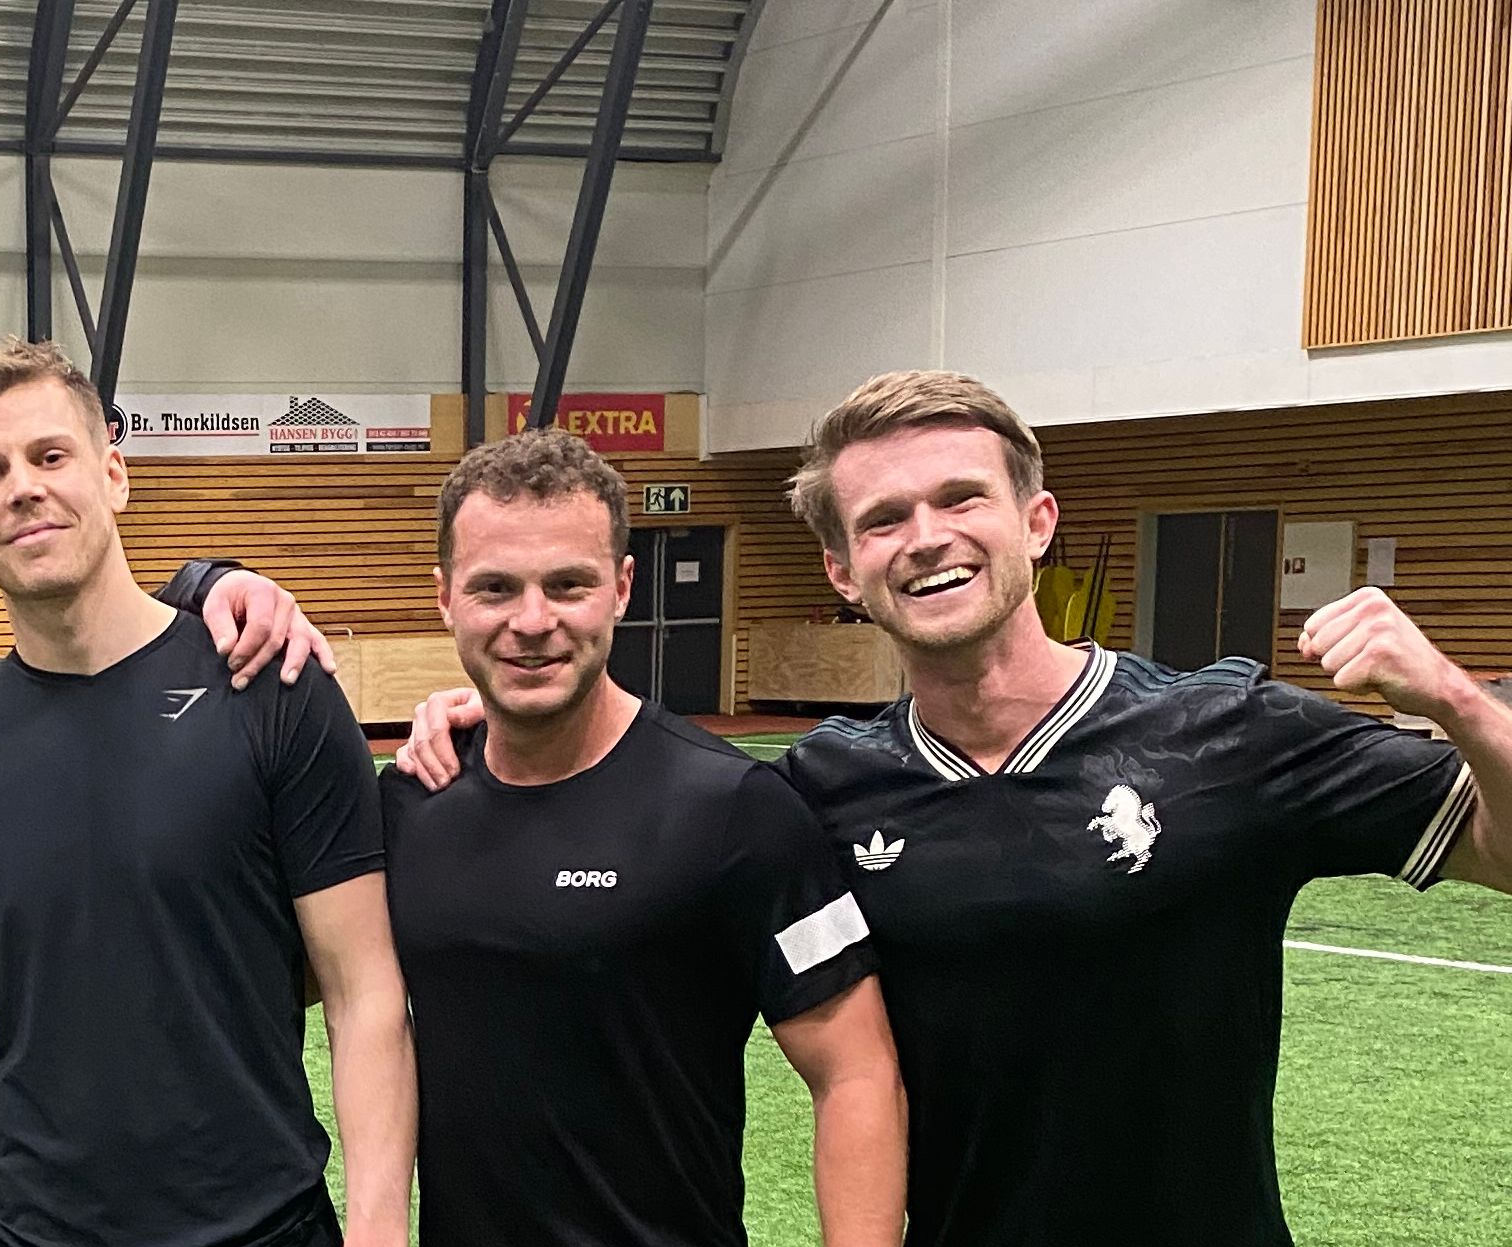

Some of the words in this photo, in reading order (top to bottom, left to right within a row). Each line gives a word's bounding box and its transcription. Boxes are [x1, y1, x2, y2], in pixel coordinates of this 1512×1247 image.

[131, 413, 154, 431] Br.
[162, 413, 260, 431] Thorkildsen
[568, 410, 657, 434] EXTRA
[270, 428, 317, 440] HANSEN
[321, 428, 353, 440] BYGG
[555, 870, 617, 888] BORG
